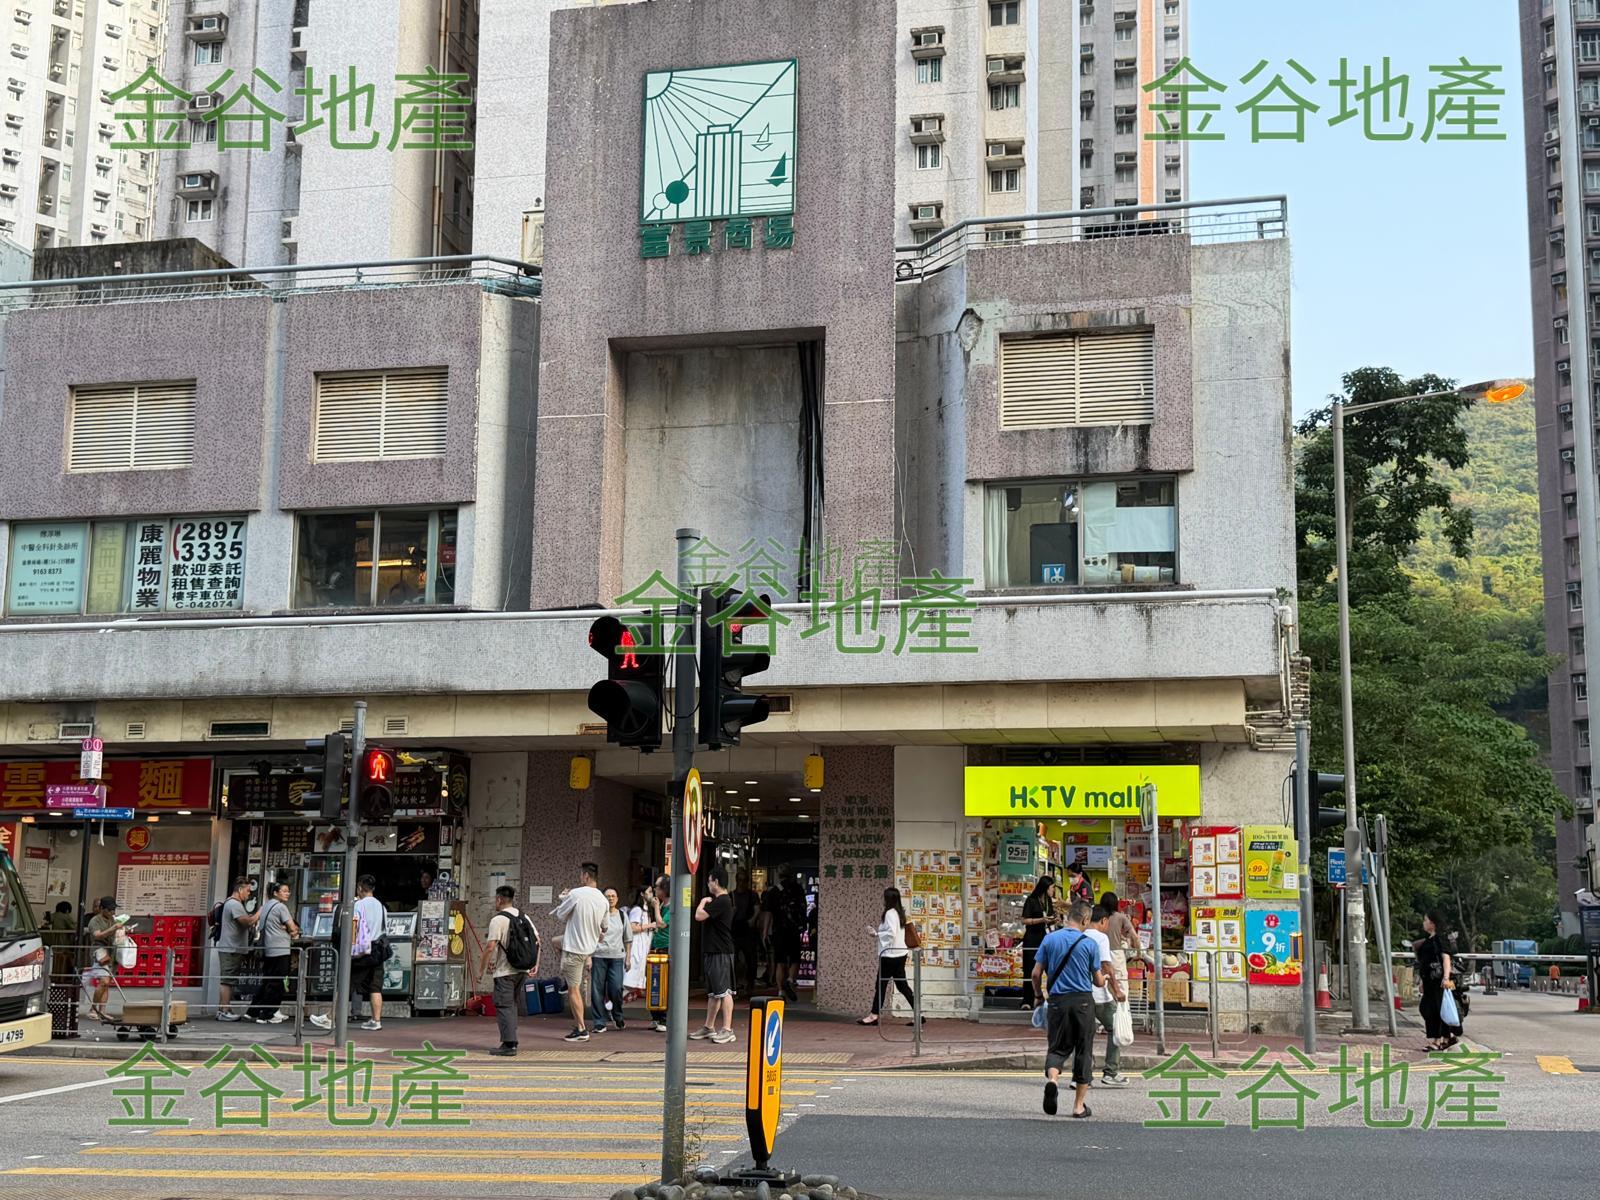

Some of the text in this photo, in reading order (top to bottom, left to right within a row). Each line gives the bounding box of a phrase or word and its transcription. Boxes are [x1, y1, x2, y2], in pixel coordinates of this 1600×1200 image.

[182, 521, 244, 541] 2897
[180, 541, 243, 562] 3335
[136, 523, 164, 608] 康麗物業
[171, 562, 242, 577] 歡迎委託
[171, 577, 241, 591] 租售查詢
[175, 600, 233, 609] C-042074
[1010, 785, 1076, 808] HKTV
[832, 848, 880, 858] GARDEN
[5, 1029, 24, 1042] 4799
